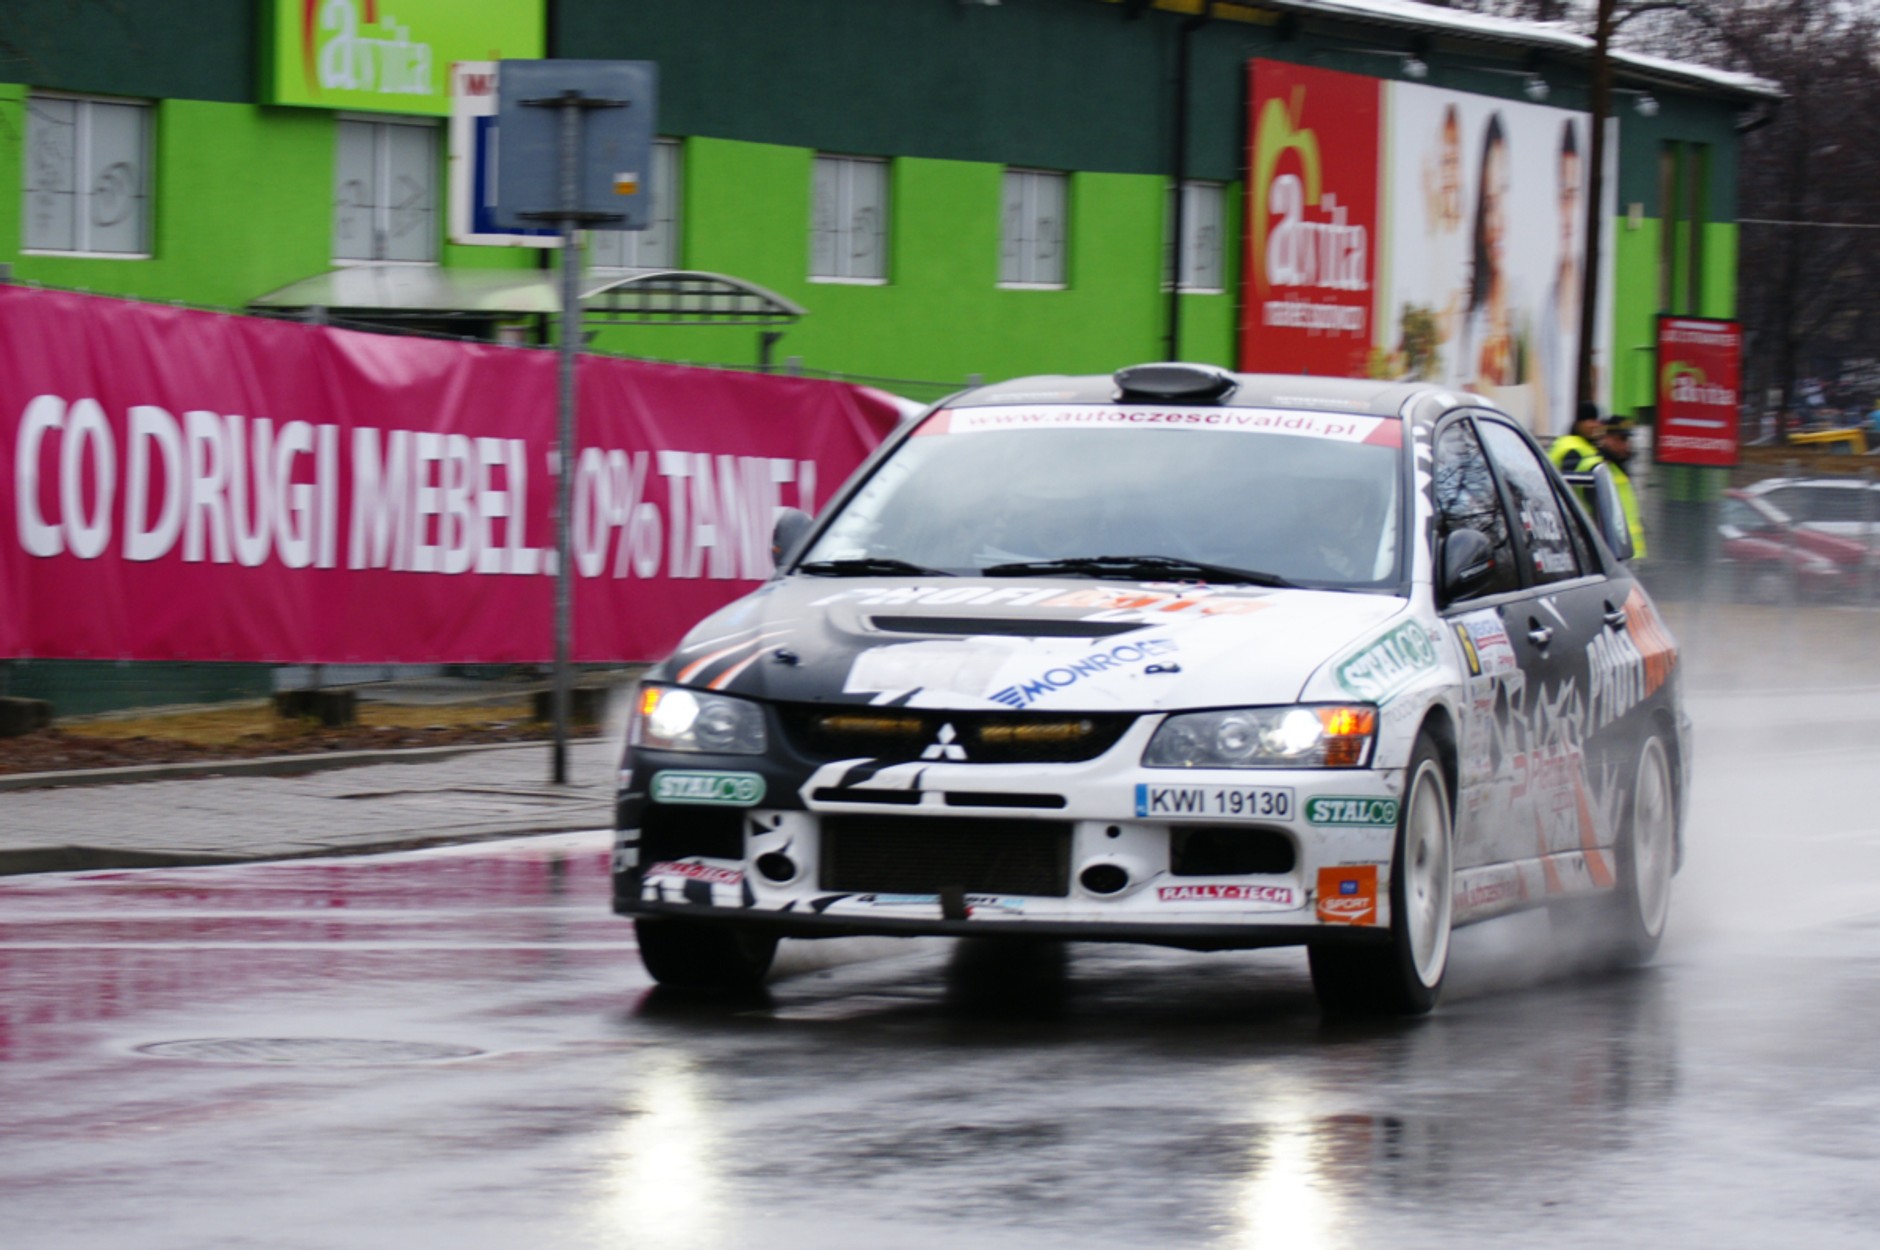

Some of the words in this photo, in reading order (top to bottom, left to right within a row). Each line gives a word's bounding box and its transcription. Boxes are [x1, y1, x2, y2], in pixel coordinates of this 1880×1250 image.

[968, 408, 1357, 437] www.autoczescivaldi.pl
[14, 394, 116, 558] CO
[122, 405, 340, 567] DRUGI
[1019, 640, 1170, 702] MONROE
[1343, 623, 1434, 701] STALCO
[657, 776, 755, 800] STALCO
[1151, 789, 1205, 813] KWI
[1215, 790, 1288, 816] 19130
[1312, 800, 1397, 823] STALCO
[1162, 884, 1289, 902] RALLY-TECH
